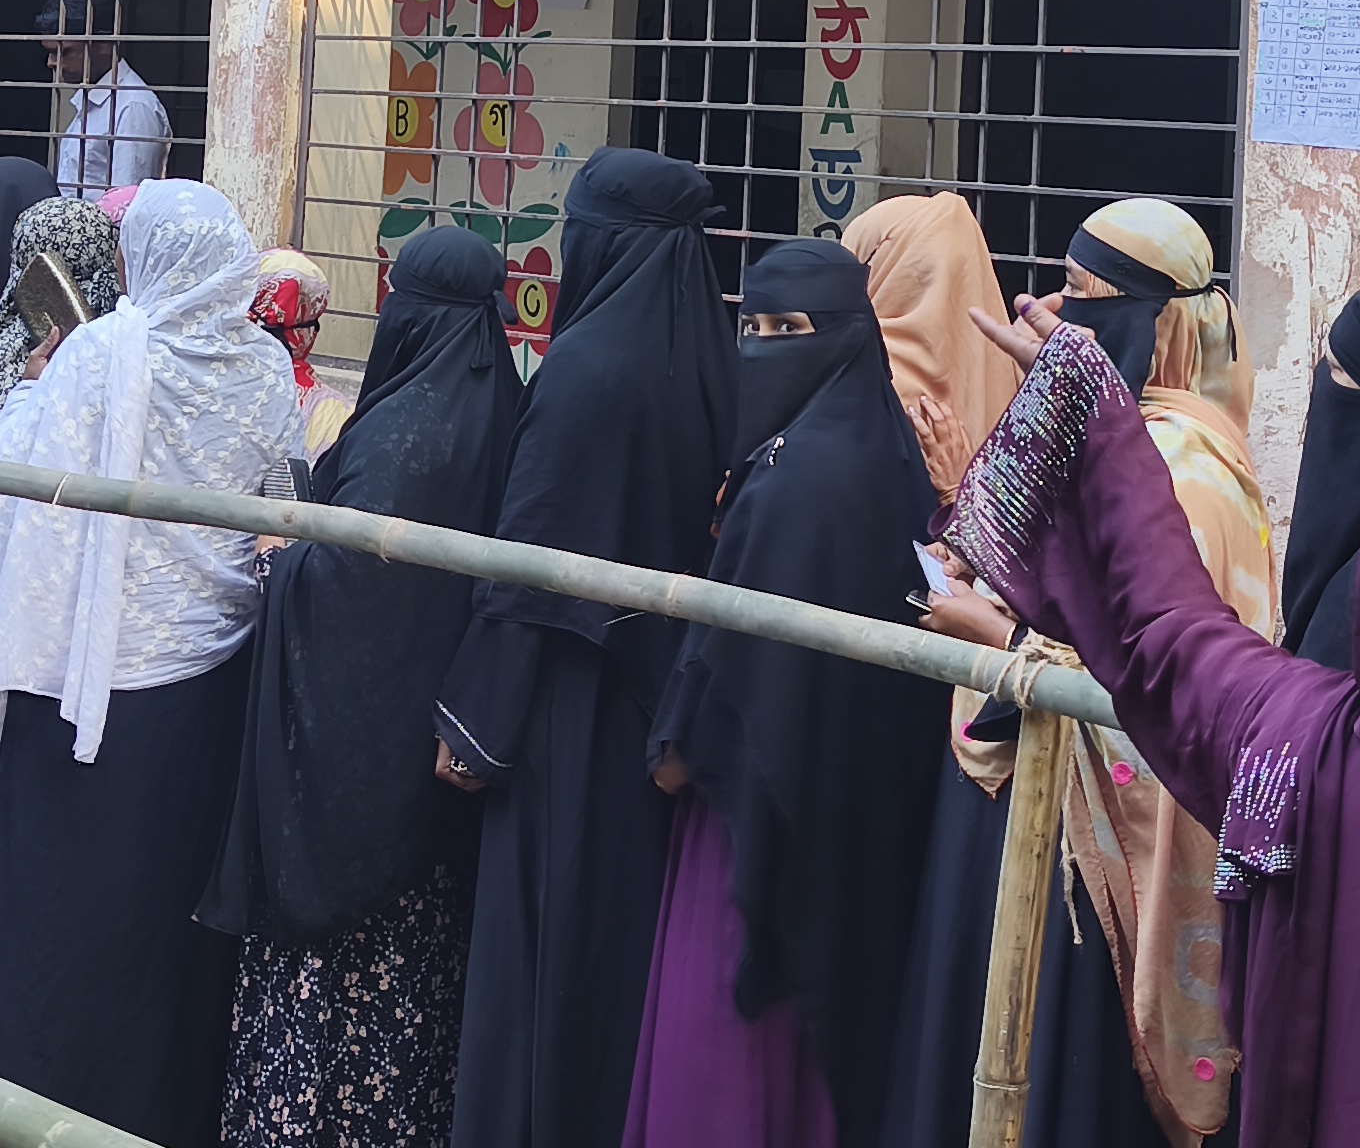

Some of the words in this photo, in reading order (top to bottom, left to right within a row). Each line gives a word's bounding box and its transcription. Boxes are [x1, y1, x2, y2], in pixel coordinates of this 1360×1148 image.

[395, 99, 409, 137] B
[820, 81, 854, 134] A
[524, 284, 540, 318] C
